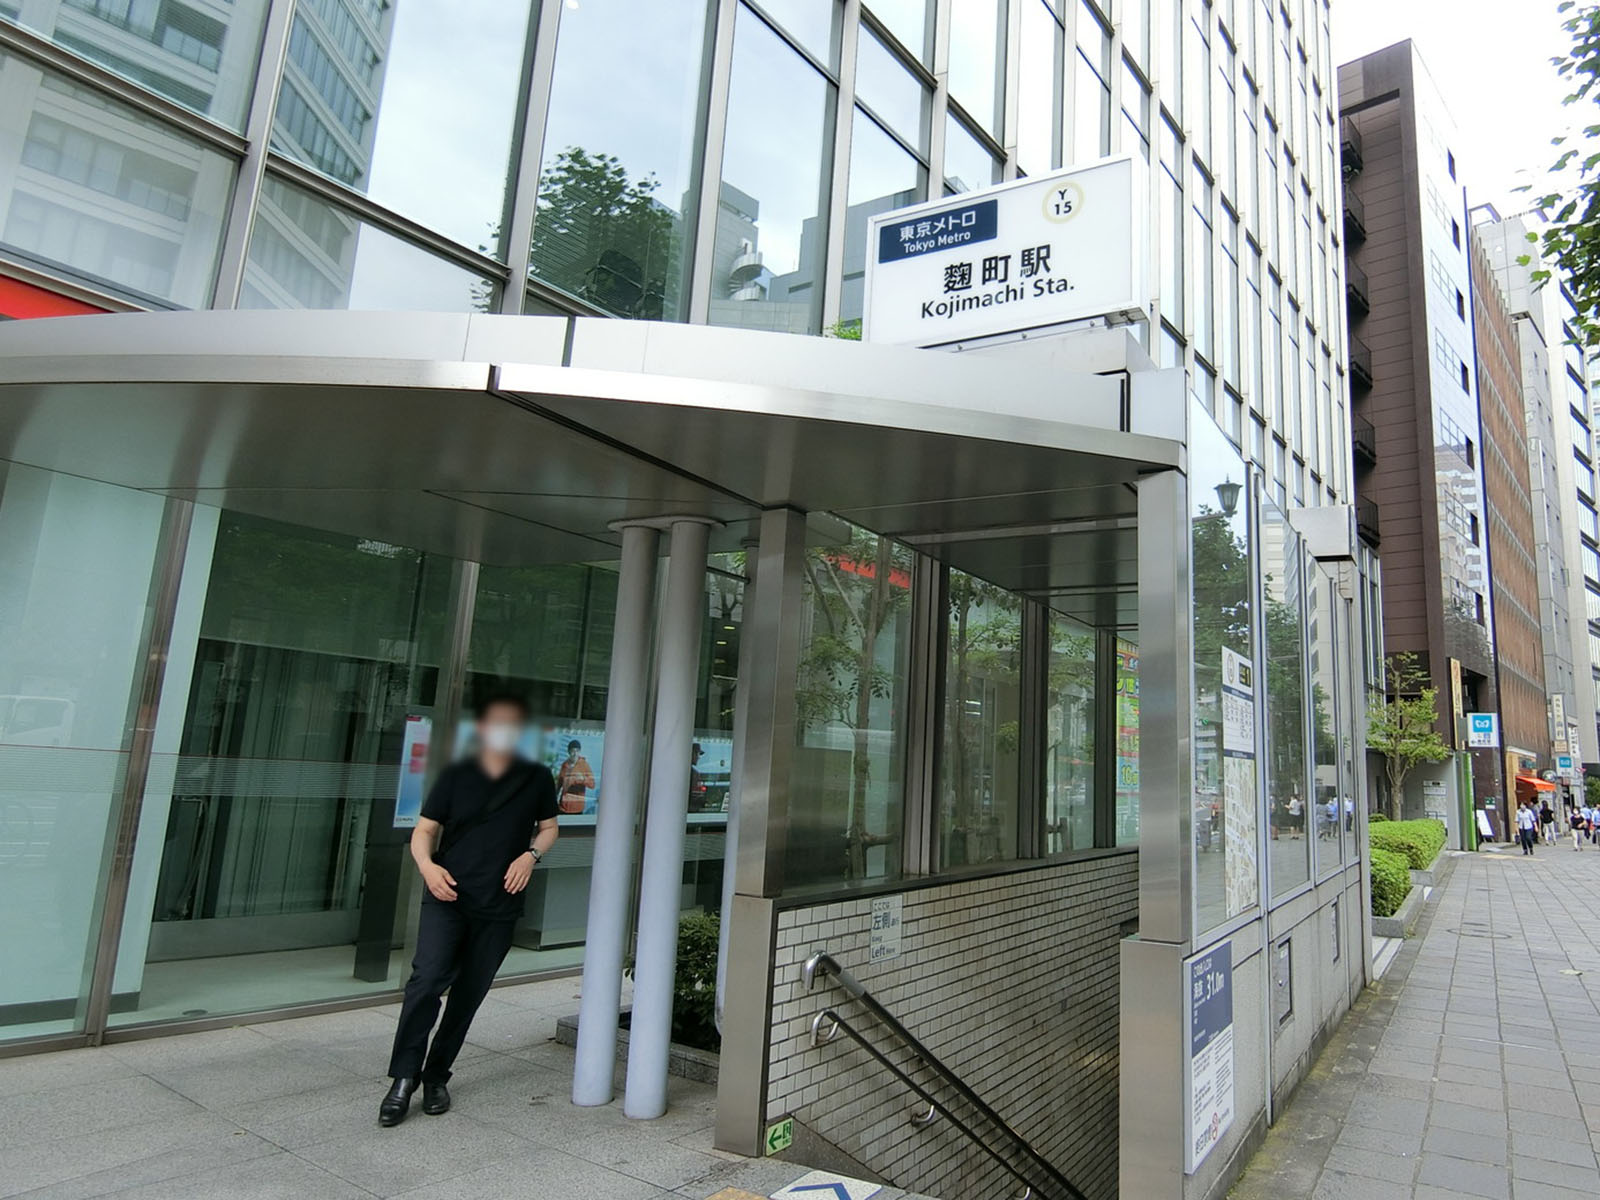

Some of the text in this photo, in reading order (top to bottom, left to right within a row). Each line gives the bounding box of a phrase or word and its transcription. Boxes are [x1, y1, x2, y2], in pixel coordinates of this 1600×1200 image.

[1058, 188, 1068, 200] Y
[1054, 201, 1073, 216] 15
[899, 210, 977, 242] 東京メトロ
[903, 230, 972, 254] Tokyo Metro
[921, 277, 1075, 319] Kojimachi Sta.
